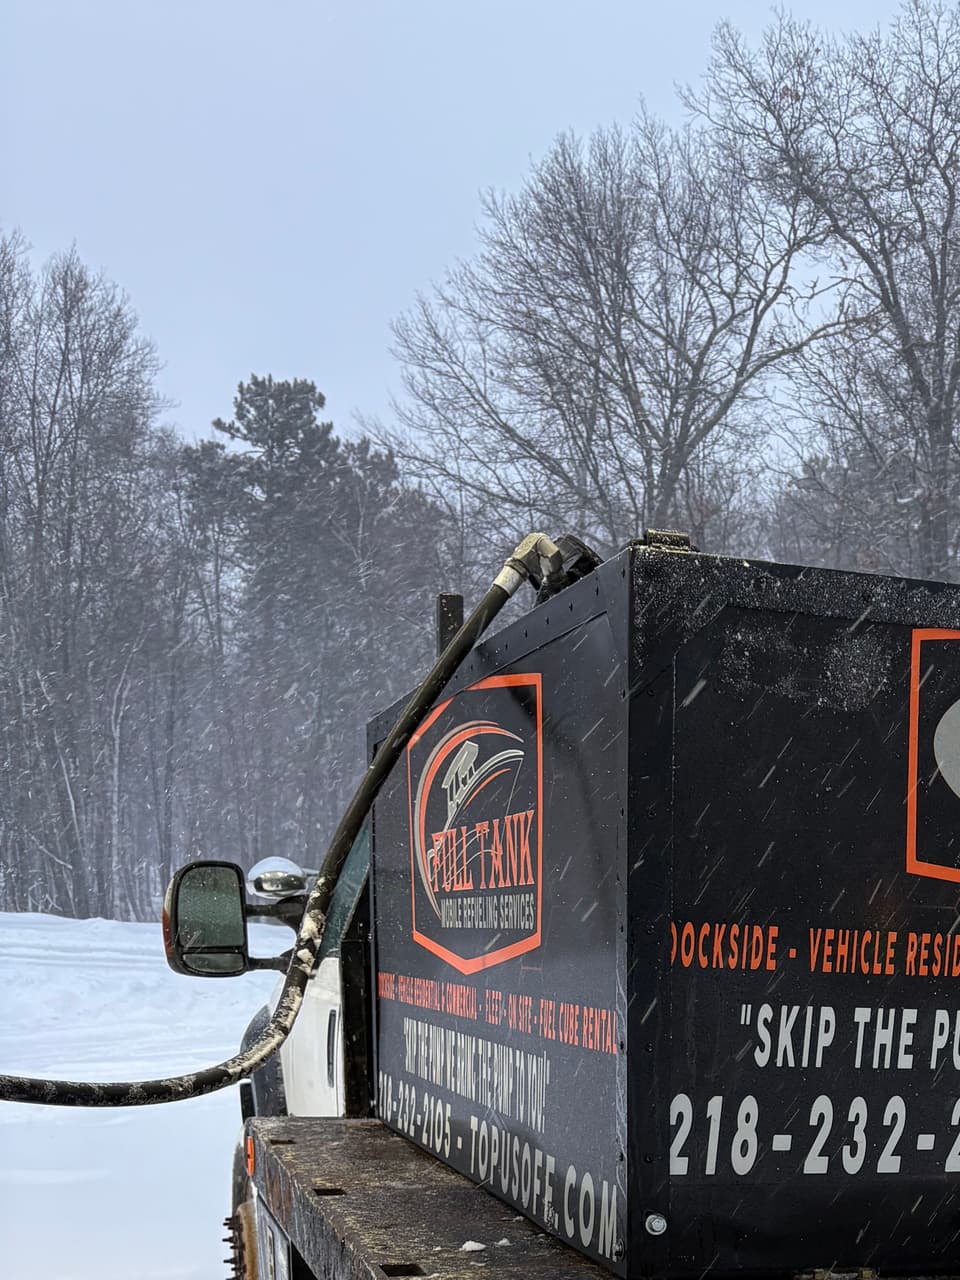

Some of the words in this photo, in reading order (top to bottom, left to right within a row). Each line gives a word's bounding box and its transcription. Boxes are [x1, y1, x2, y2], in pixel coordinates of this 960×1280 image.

[431, 826, 474, 892] FULL
[475, 810, 535, 889] TANK
[463, 895, 498, 929] REFUELING
[499, 892, 535, 930] SERVICES
[808, 927, 897, 976] VEHICLE
[518, 994, 532, 1034] SITE
[540, 999, 556, 1041] FUEL
[559, 1002, 580, 1048] CUBE
[583, 1006, 618, 1055] RENTAL
[740, 1003, 836, 1068] "SKIP
[854, 1007, 918, 1069] THE
[478, 1038, 492, 1109] THE
[493, 1042, 513, 1118] PUMP
[516, 1049, 525, 1124] TO
[379, 1070, 451, 1158] 218-232-2105
[470, 1115, 617, 1262] TOPUSOFF.COM
